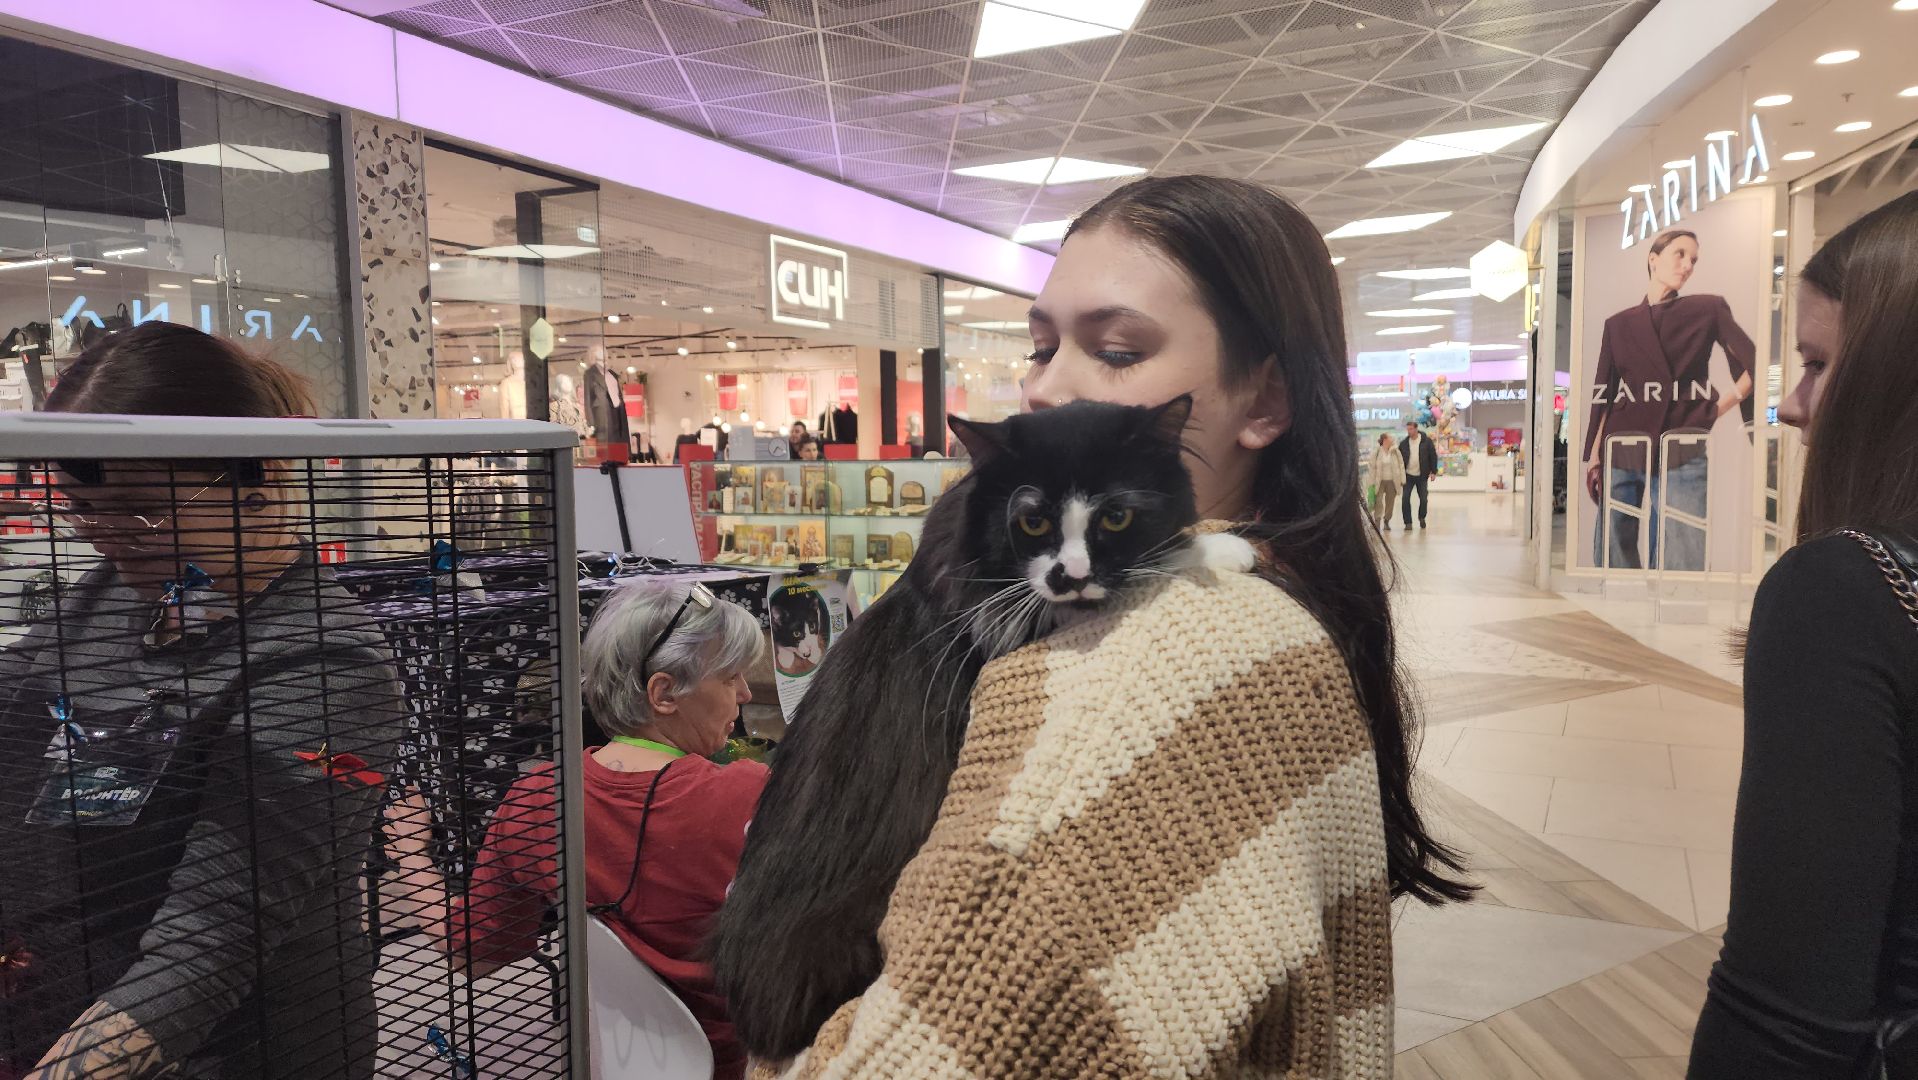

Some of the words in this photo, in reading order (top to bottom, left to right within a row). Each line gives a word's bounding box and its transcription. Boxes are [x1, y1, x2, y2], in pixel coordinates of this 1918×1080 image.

[1620, 113, 1770, 250] ZARINA
[1472, 389, 1515, 401] NATURA
[1591, 376, 1716, 404] ZARIN
